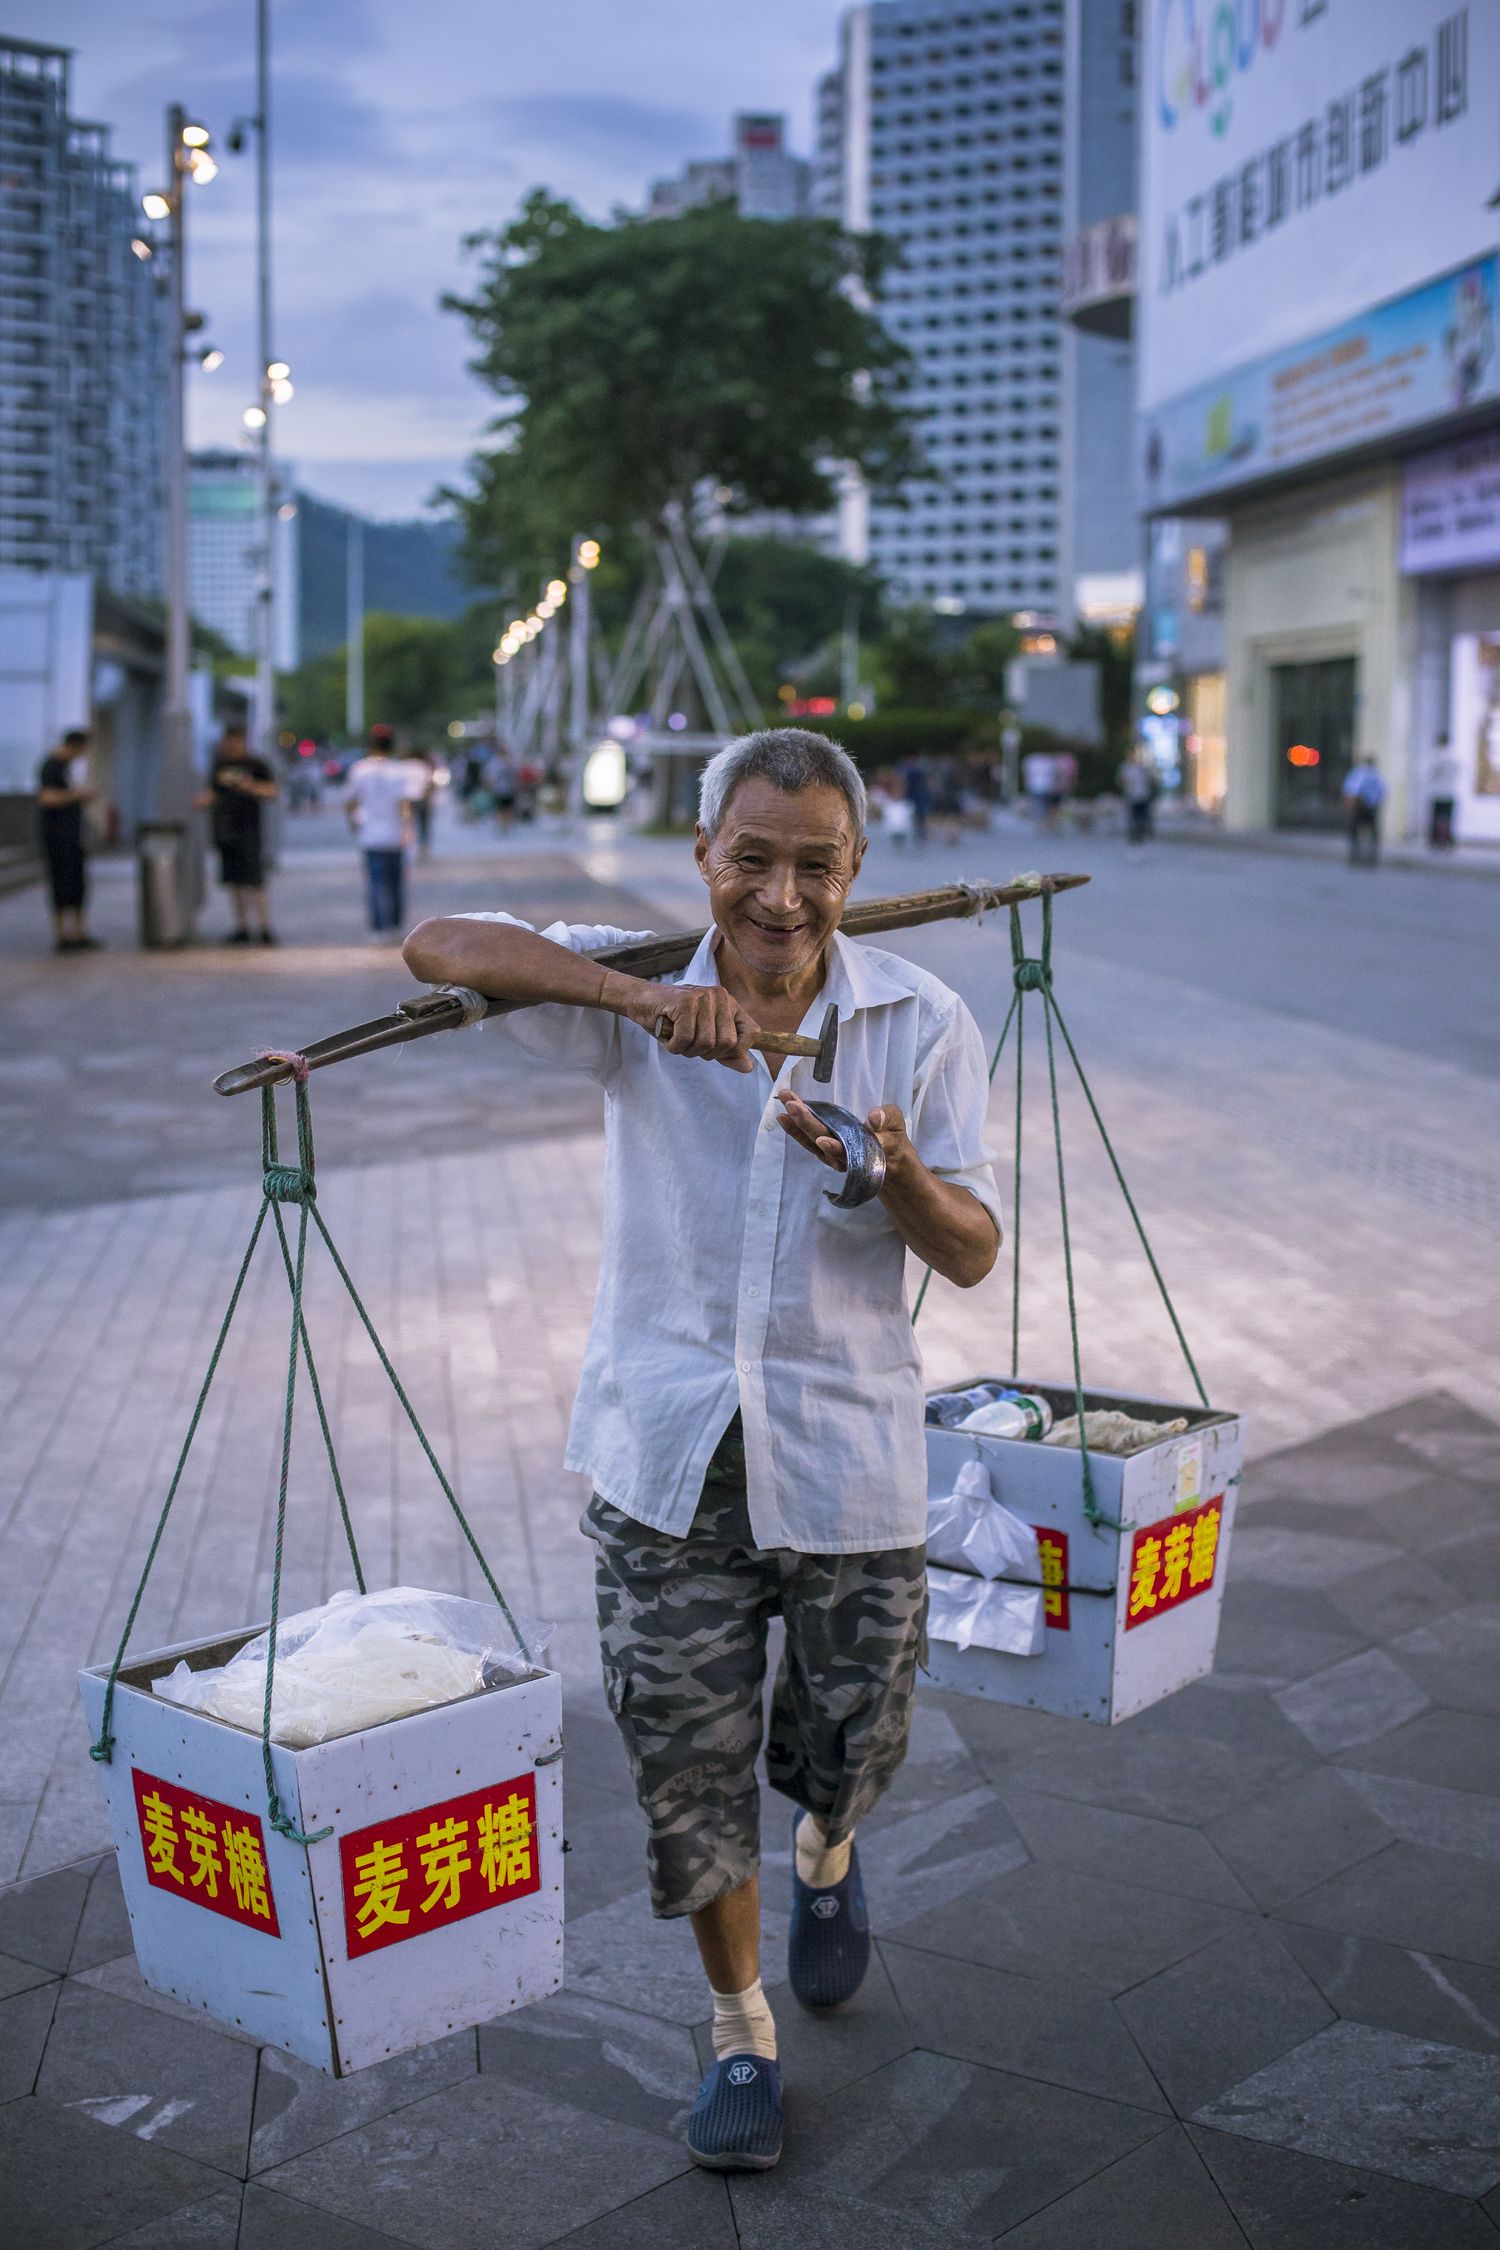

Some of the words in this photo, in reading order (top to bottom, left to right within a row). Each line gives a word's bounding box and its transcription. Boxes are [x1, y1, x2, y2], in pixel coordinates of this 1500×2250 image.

[1130, 1509, 1220, 1616] 麦芽糖
[142, 1791, 270, 1919] 麦芽糖
[353, 1793, 532, 1938] 麦芽糖
